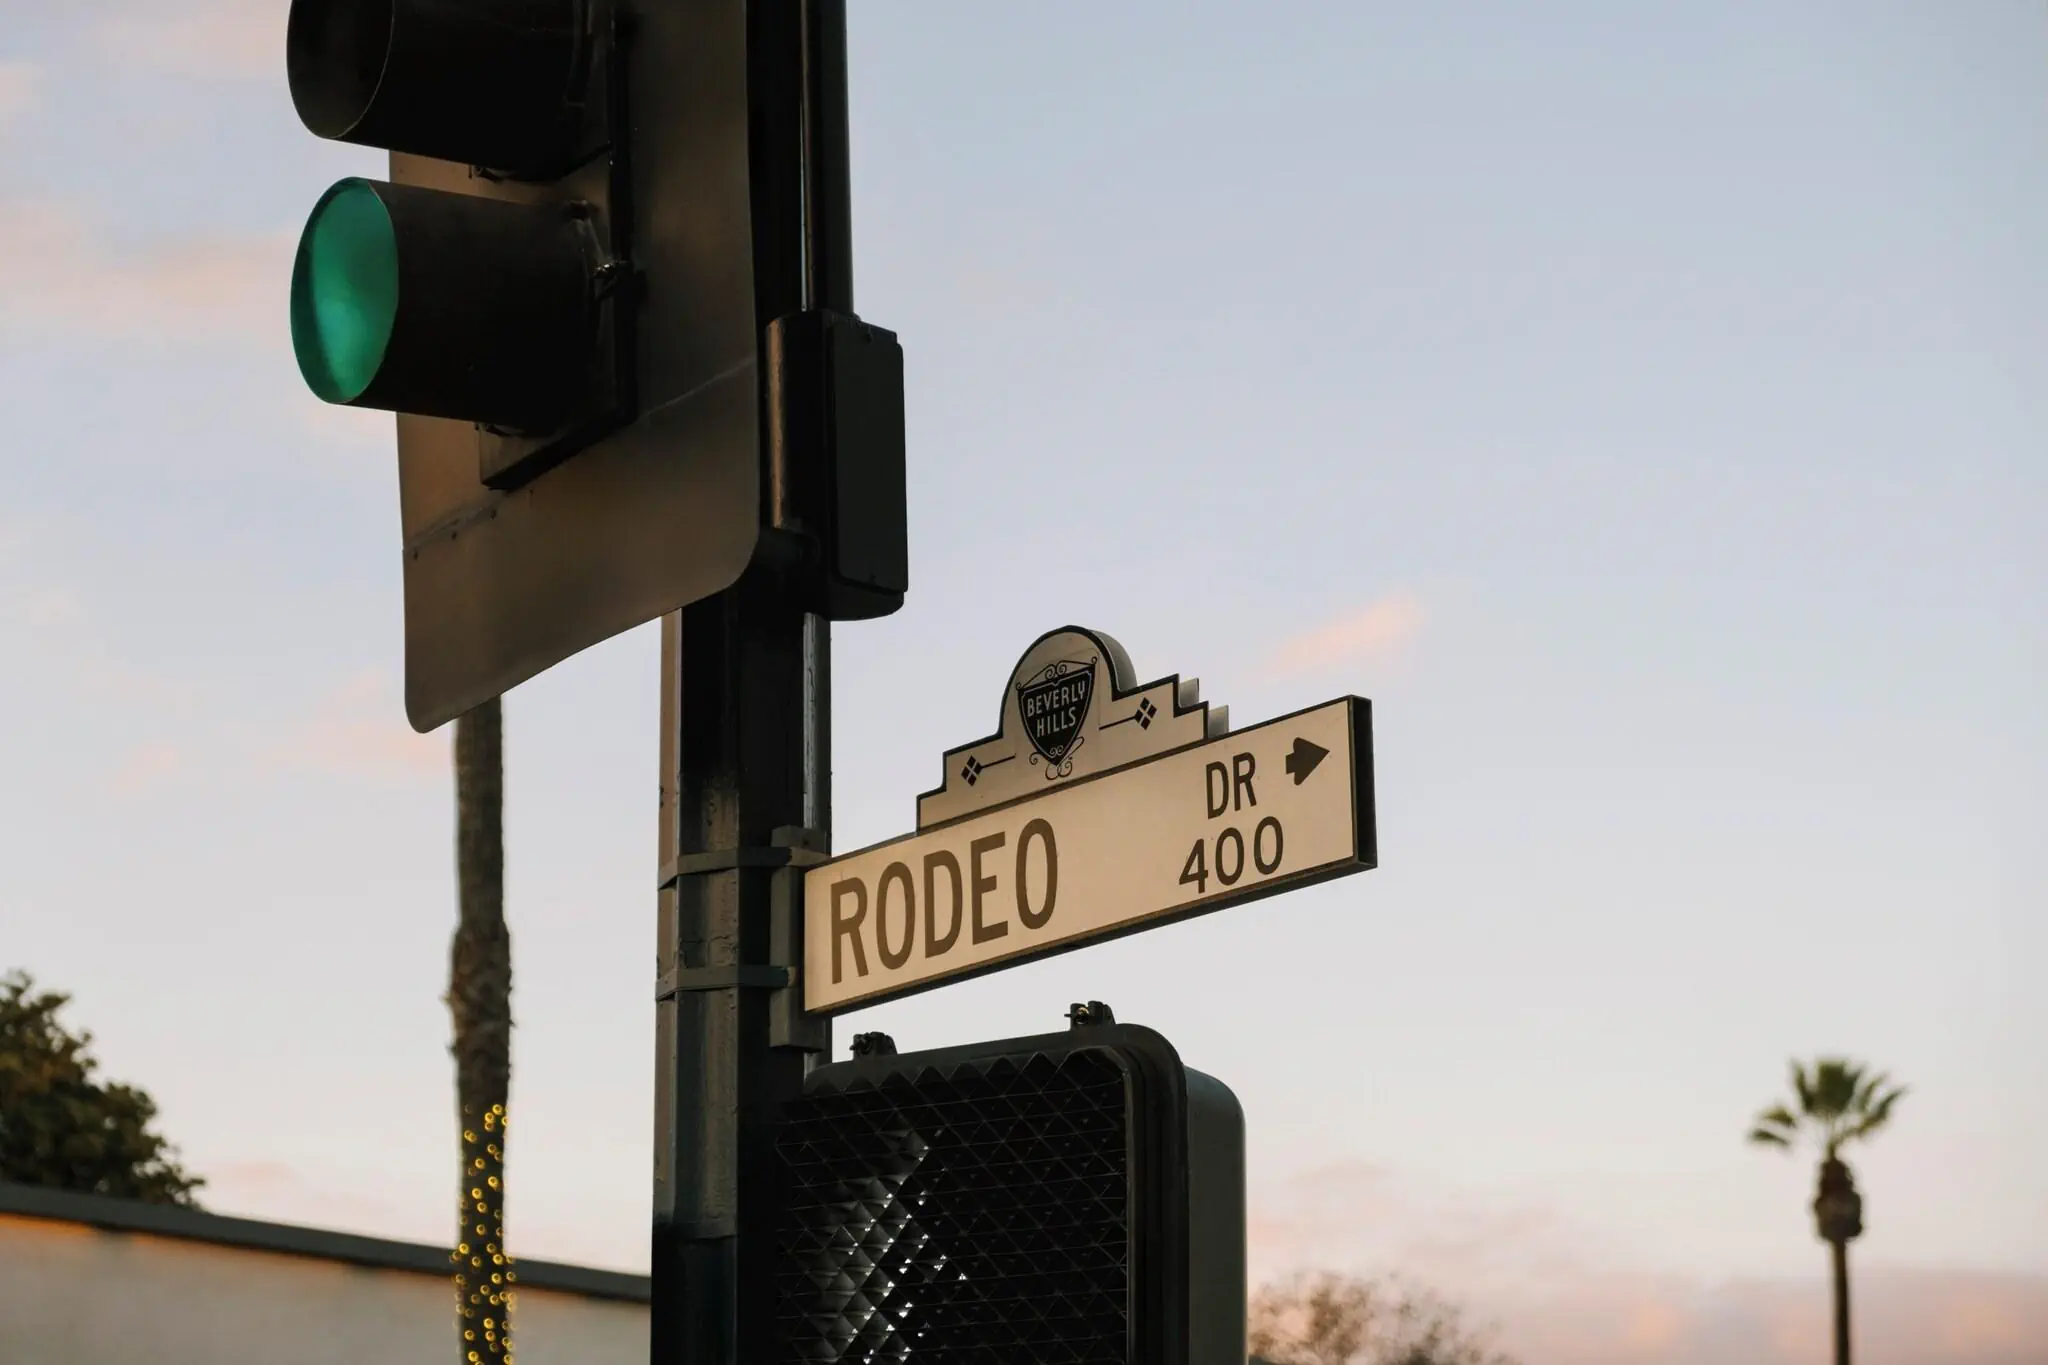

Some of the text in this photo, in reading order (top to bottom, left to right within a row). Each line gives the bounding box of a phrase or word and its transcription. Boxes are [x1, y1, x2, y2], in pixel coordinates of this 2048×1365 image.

[1027, 680, 1086, 717] BEVERLY
[1037, 706, 1077, 738] HILLS
[830, 752, 1257, 985] RODEO DR
[1179, 816, 1284, 894] 400
